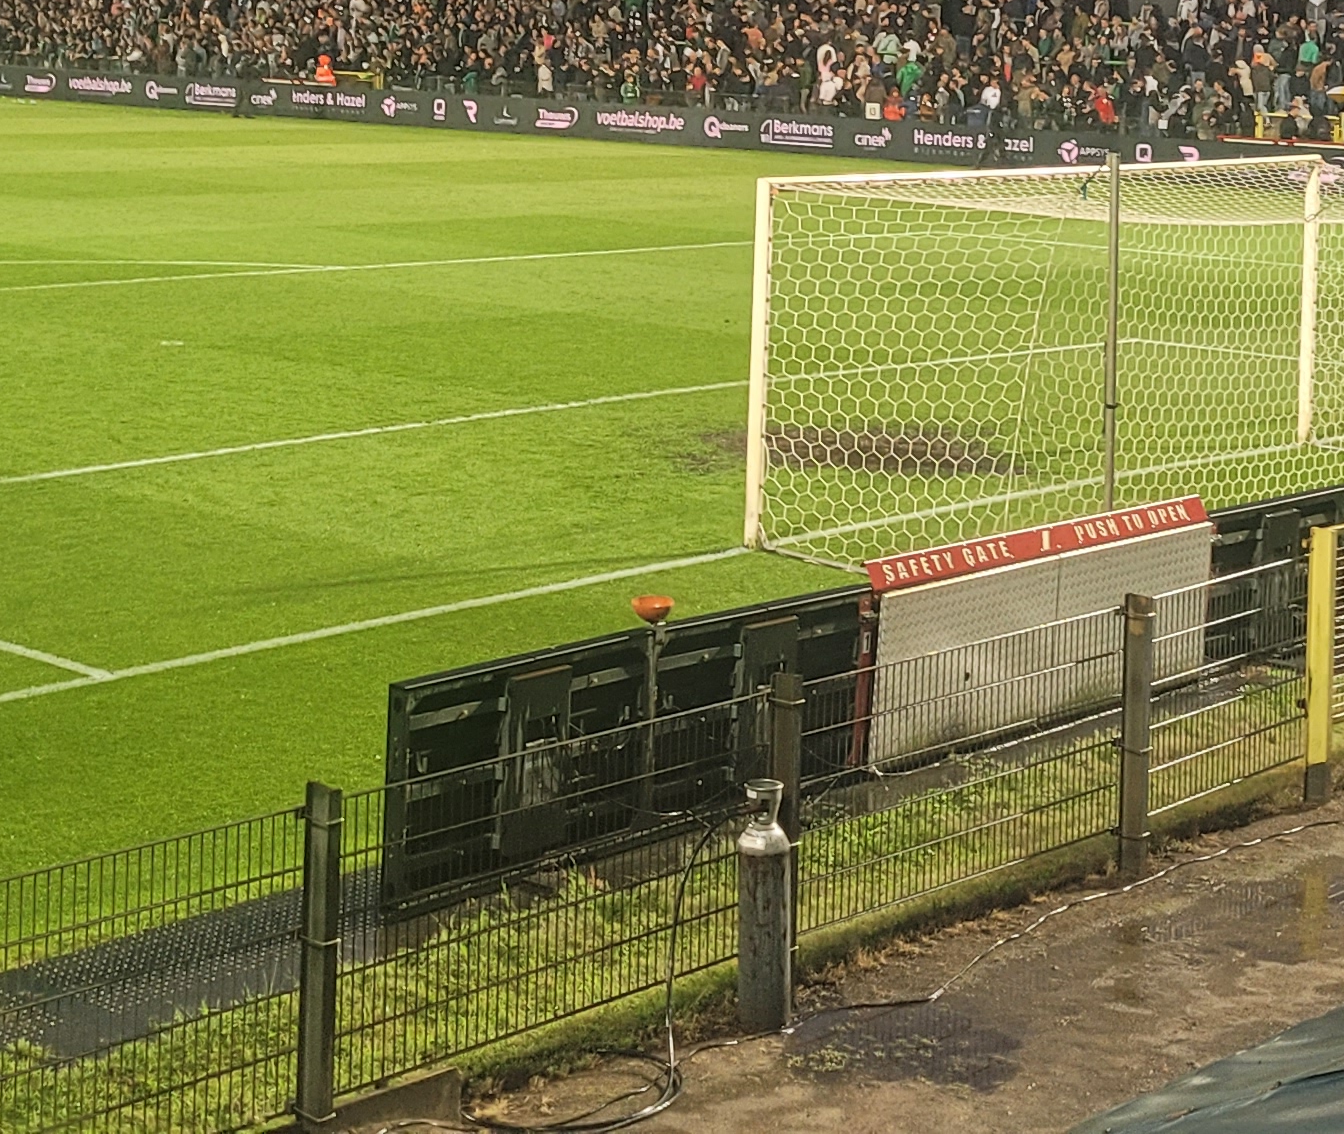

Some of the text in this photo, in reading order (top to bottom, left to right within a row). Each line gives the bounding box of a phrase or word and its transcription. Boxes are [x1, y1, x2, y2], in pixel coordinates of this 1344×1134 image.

[326, 92, 334, 106] &
[336, 92, 366, 108] Hazel
[596, 110, 685, 132] voetbalshop.be
[773, 119, 834, 137] Berkmans
[913, 129, 974, 148] Henders
[977, 134, 987, 149] &
[881, 551, 955, 585] SAFETY
[961, 540, 1015, 567] GATE
[1073, 517, 1120, 544] PUSH
[1120, 513, 1144, 531] TO
[1147, 504, 1192, 529] OPEN
